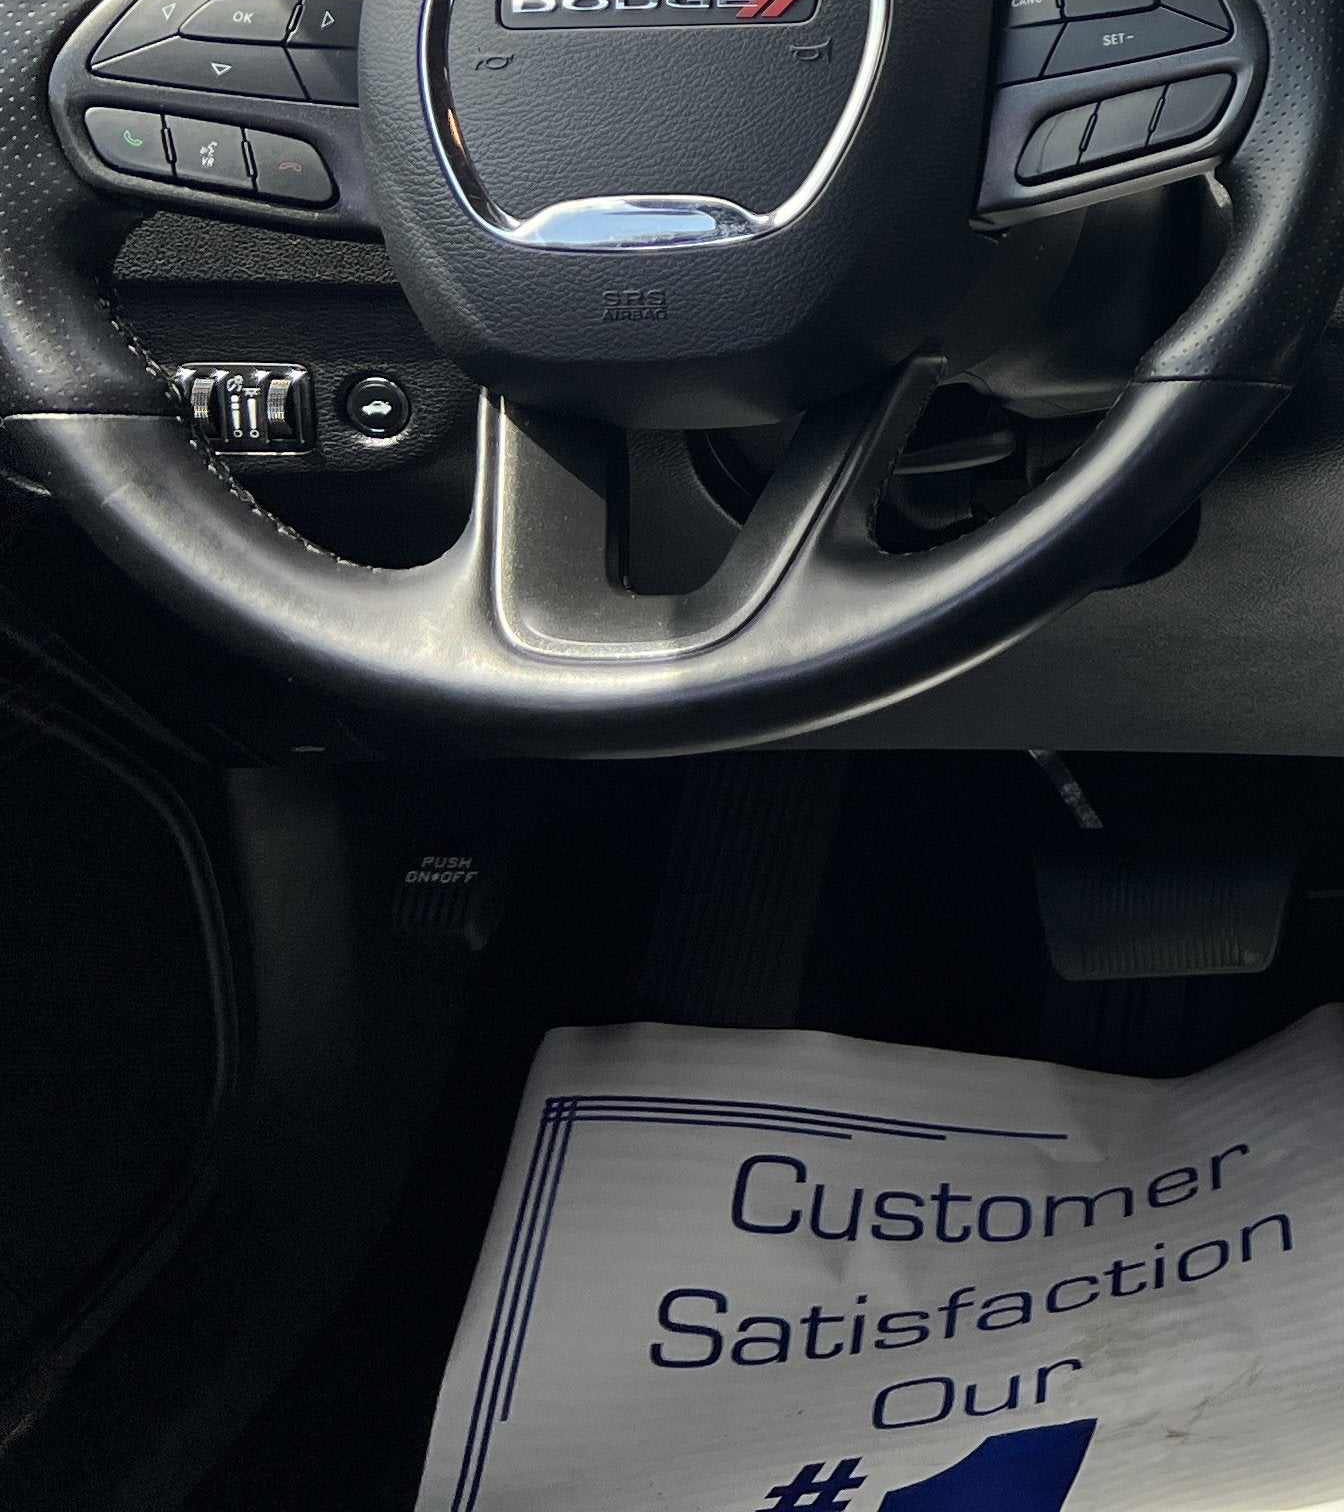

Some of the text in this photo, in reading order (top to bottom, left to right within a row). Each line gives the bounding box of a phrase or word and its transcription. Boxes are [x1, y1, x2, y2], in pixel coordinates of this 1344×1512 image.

[232, 10, 254, 24] OK
[420, 856, 473, 869] PUSH
[730, 1143, 1251, 1242] Customer
[648, 1212, 1294, 1369] Satisfaction
[870, 1356, 1084, 1430] Our
